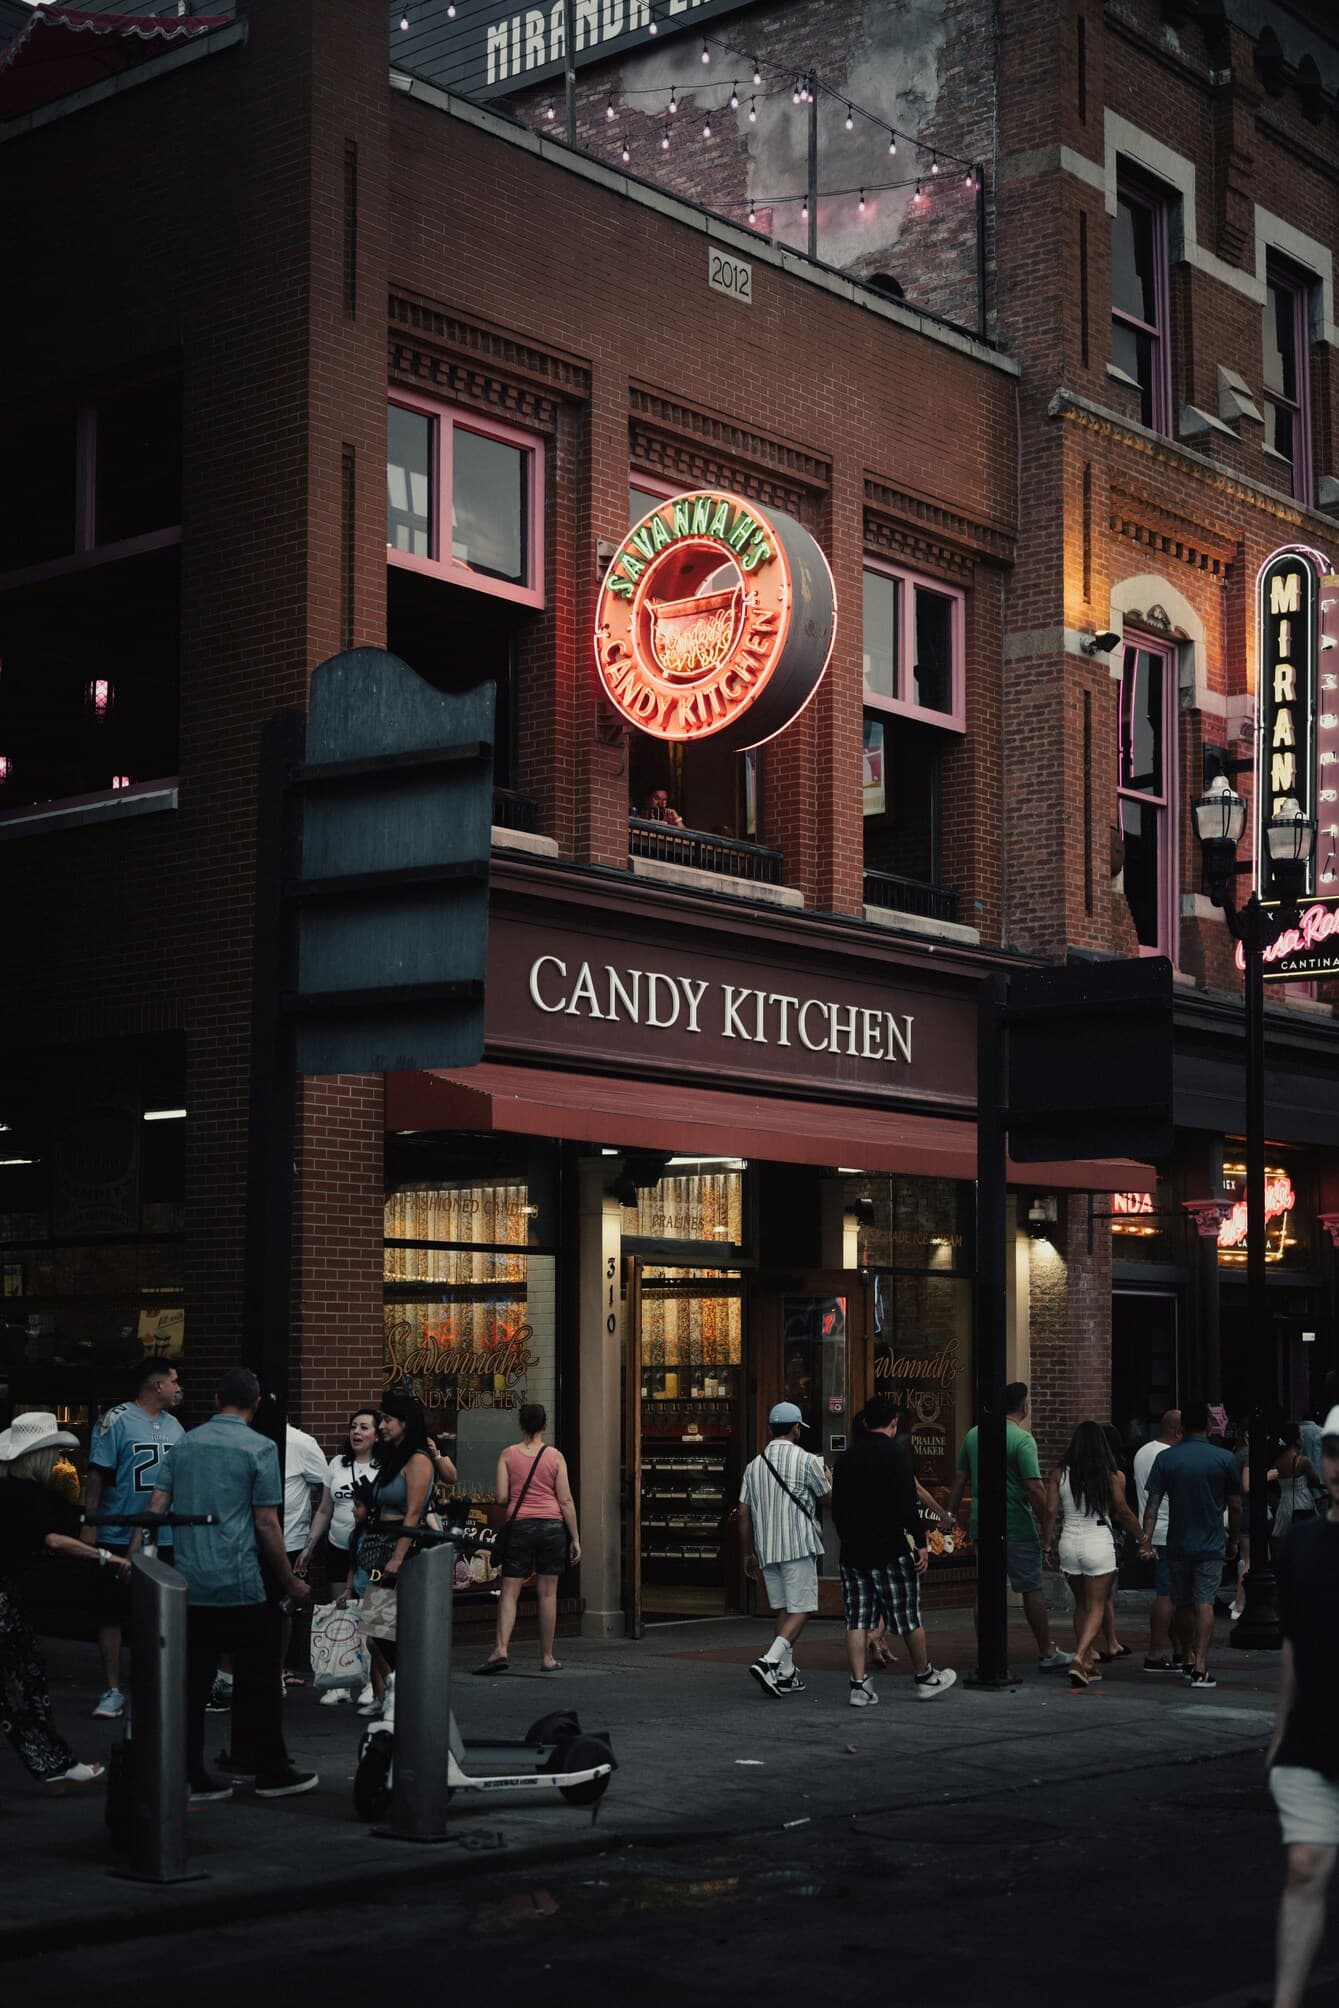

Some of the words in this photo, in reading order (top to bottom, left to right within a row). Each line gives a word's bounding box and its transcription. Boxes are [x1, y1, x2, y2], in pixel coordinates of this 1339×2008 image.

[487, 0, 650, 85] MIRANDA
[712, 256, 749, 297] 2012
[606, 497, 771, 599] SAVANNAH'S
[603, 640, 672, 731] CANDY
[680, 608, 776, 731] KITCHEN
[1270, 574, 1301, 881] MIRAN
[1281, 957, 1339, 971] CANTINA
[529, 955, 710, 1033] CANDY
[721, 984, 915, 1065] KITCHEN
[404, 1193, 479, 1214] FASHIONED
[652, 1213, 704, 1231] PRALINES
[607, 1257, 616, 1334] 310
[412, 1388, 451, 1409] NDY
[456, 1386, 526, 1411] KITCHEN
[911, 1434, 945, 1446] PRALINE
[913, 1445, 945, 1456] MAKER
